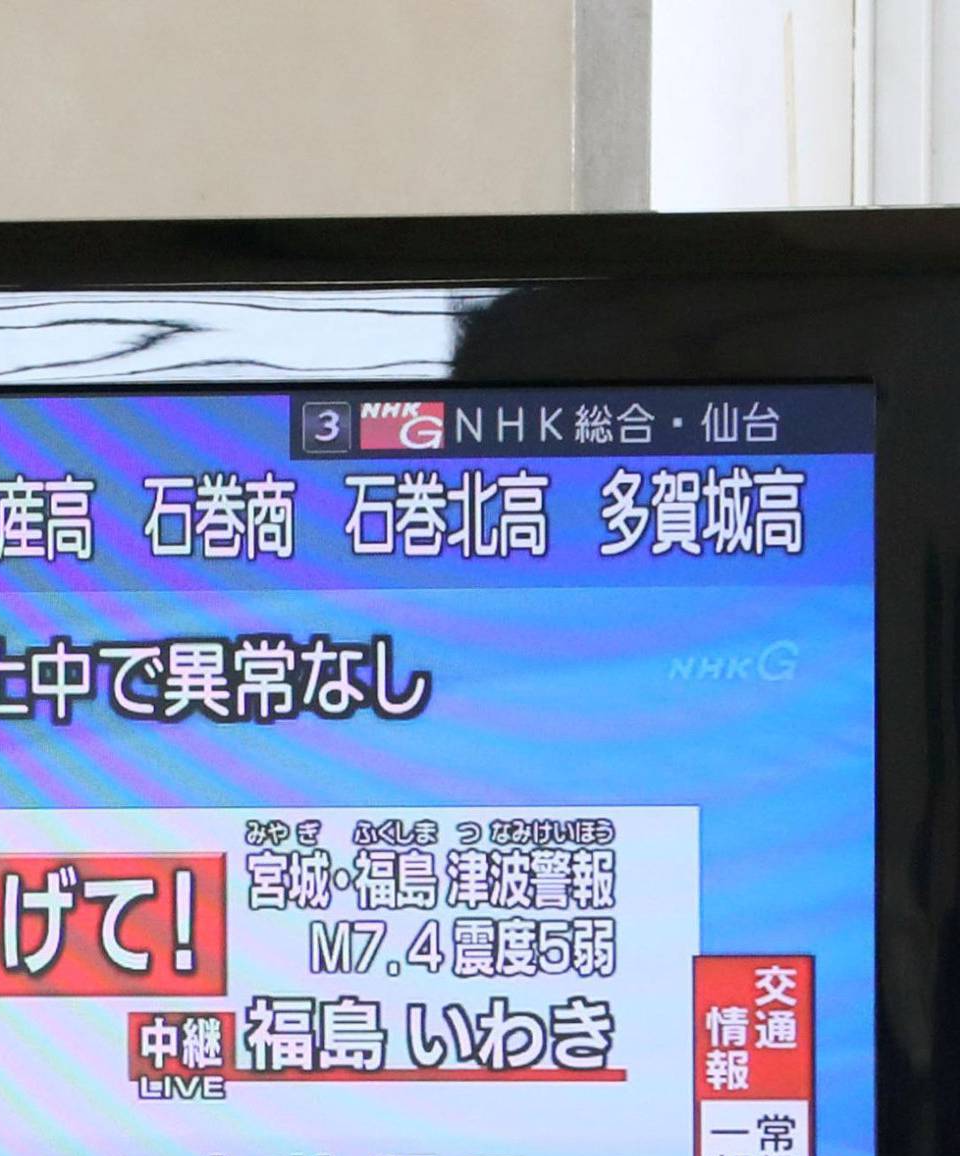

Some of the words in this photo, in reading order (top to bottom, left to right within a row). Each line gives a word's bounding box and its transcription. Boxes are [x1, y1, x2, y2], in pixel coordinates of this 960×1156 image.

[314, 408, 341, 442] 3
[144, 473, 296, 559] 石巻商
[344, 470, 549, 558] 石巻北高
[599, 467, 805, 556] 多賀城高
[245, 820, 322, 846] みやぎ
[353, 820, 439, 845] ふくしま
[246, 849, 438, 911] 宮城・福島
[446, 848, 616, 911] 津波警報
[309, 919, 444, 977] M7.4
[453, 916, 616, 978] 震度5弱
[245, 997, 386, 1071] 福島
[407, 997, 616, 1071] いわき
[754, 965, 798, 1050] 交通
[139, 1015, 223, 1071] 中継
[704, 1005, 749, 1091] 情報
[138, 1075, 227, 1100] LIVE
